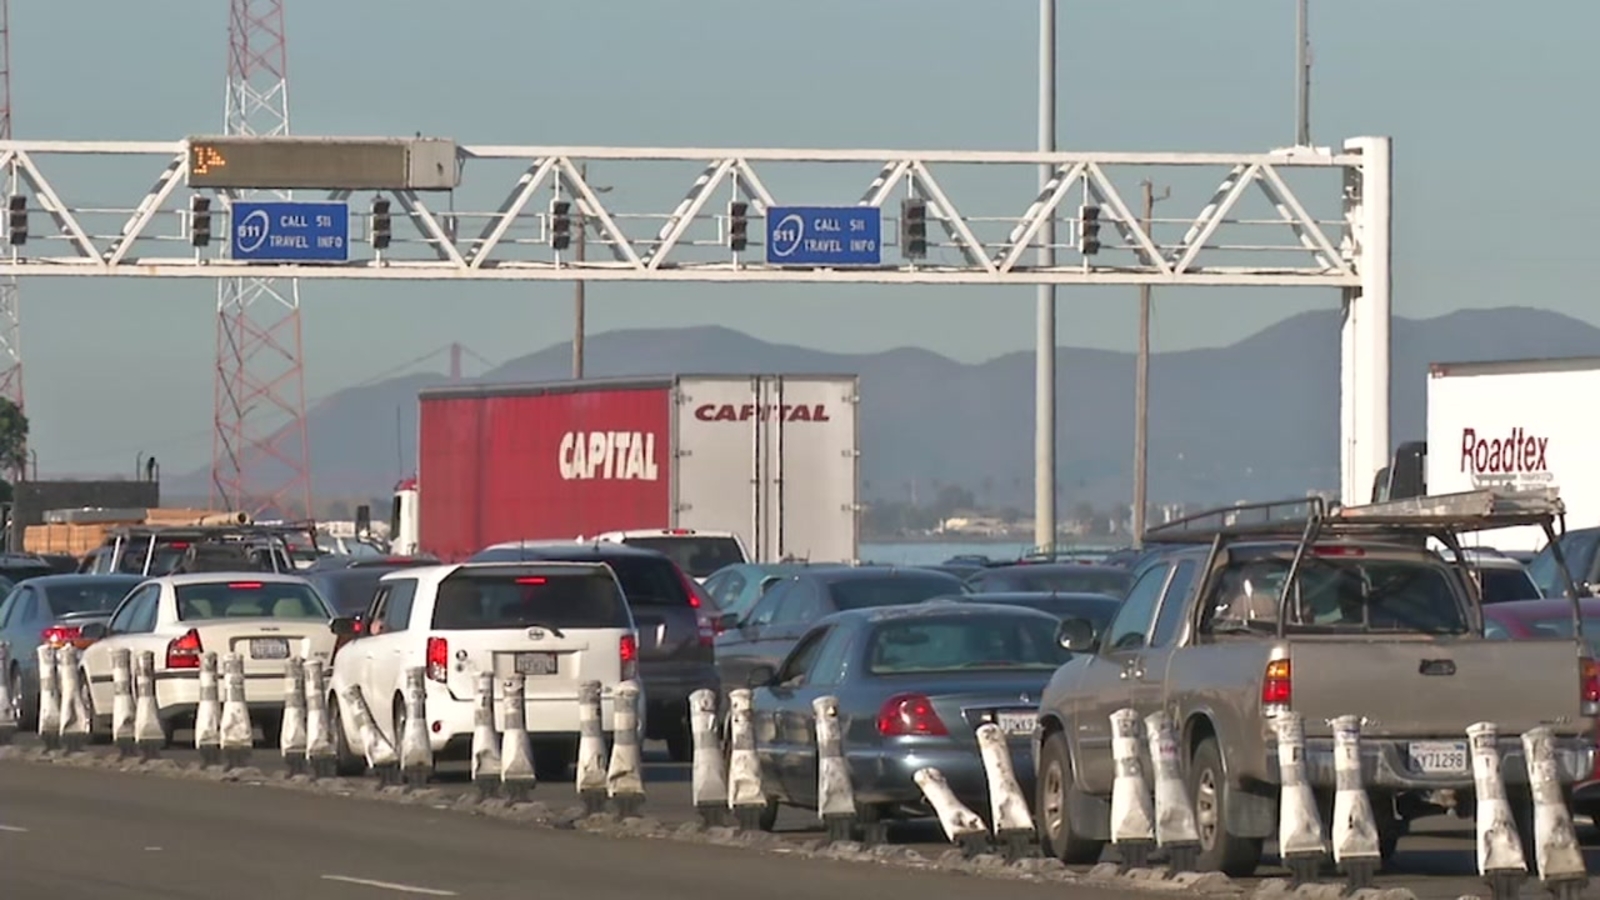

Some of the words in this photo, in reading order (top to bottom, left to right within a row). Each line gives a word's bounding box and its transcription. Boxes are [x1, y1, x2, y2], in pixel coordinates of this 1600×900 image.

[280, 215, 308, 228] CALL
[316, 215, 332, 227] 511
[814, 219, 841, 232] CALL
[849, 219, 865, 232] 511
[237, 225, 260, 238] 511
[773, 229, 796, 242] 511
[269, 235, 310, 248] TRAVEL
[317, 235, 343, 249] INFO
[804, 239, 842, 252] TRAVEL
[849, 239, 876, 252] INFO
[694, 404, 830, 422] CAPITAL
[558, 431, 658, 480] CAPITAL
[1460, 427, 1549, 474] Roadtex
